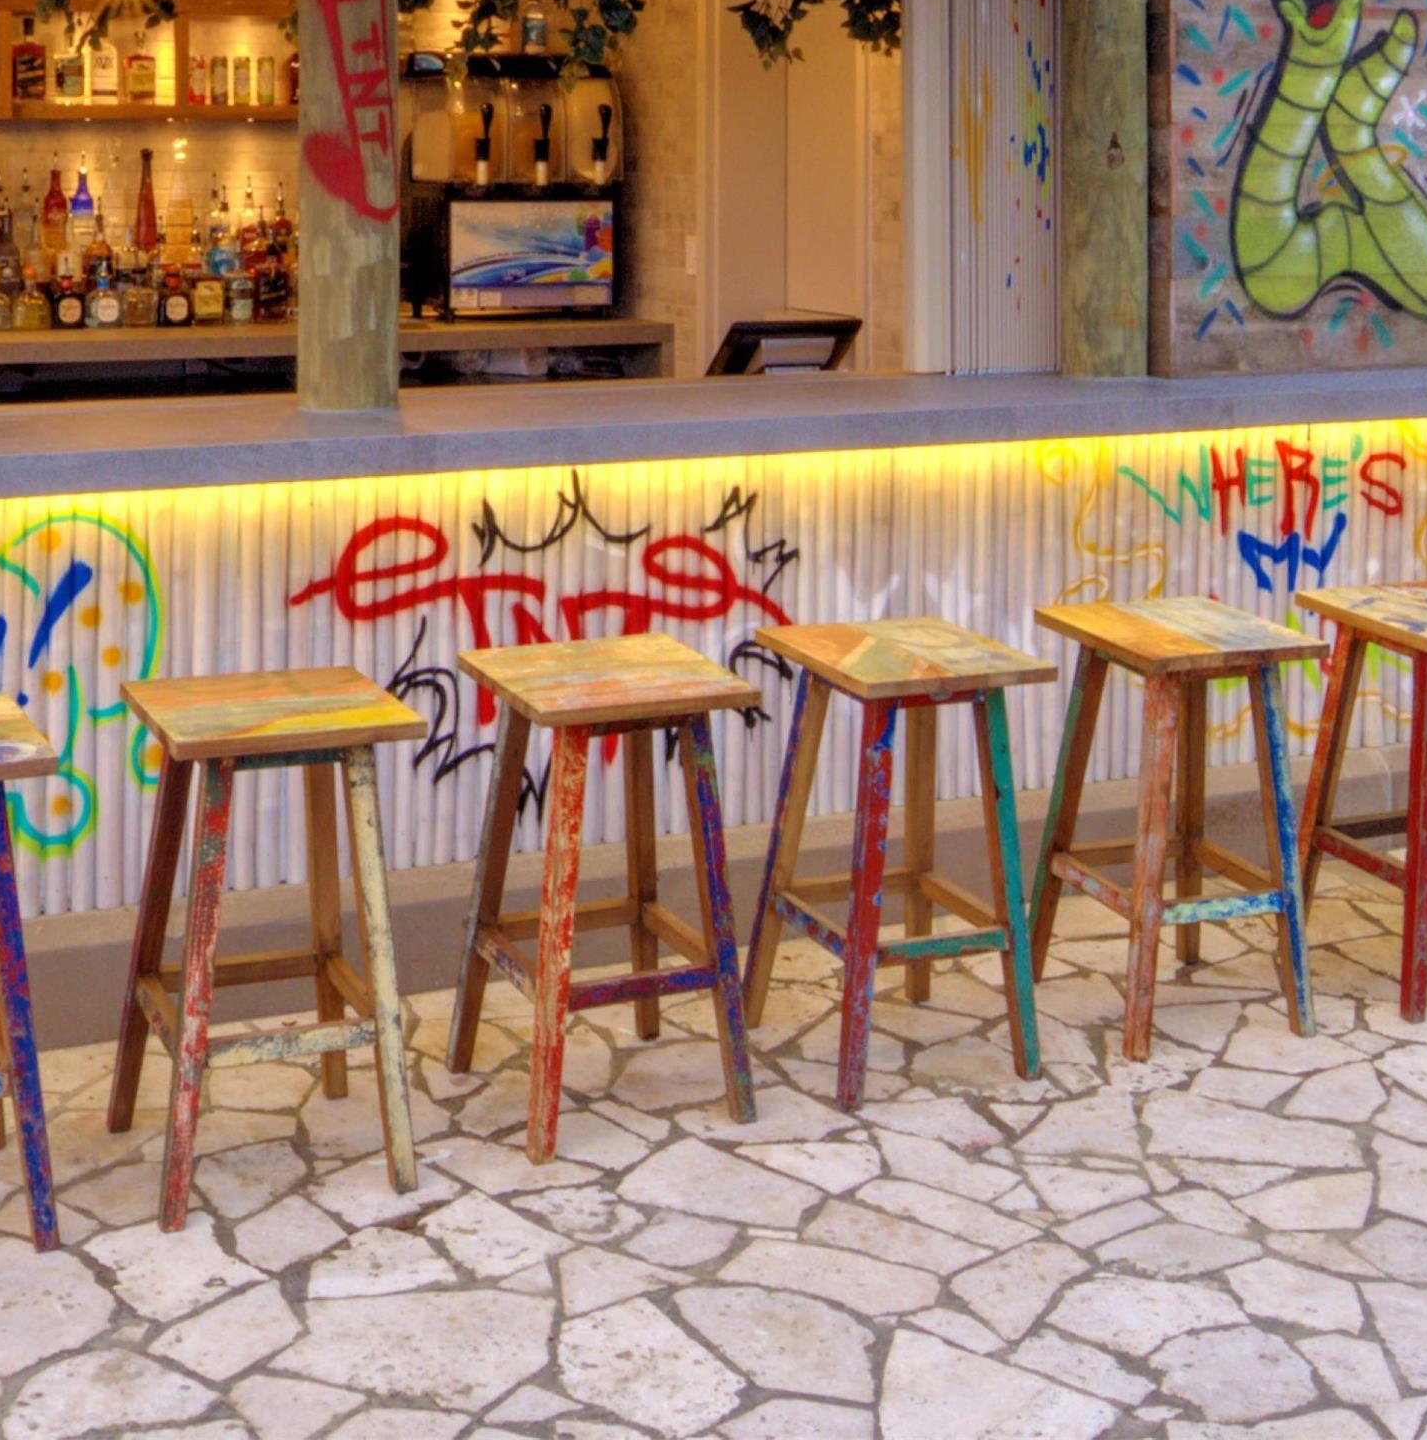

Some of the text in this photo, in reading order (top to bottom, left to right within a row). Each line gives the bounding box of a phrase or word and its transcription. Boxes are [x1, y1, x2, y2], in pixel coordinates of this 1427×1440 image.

[351, 21, 392, 159] TNT
[1118, 435, 1407, 541] WHERE'S
[1237, 512, 1347, 616] MY
